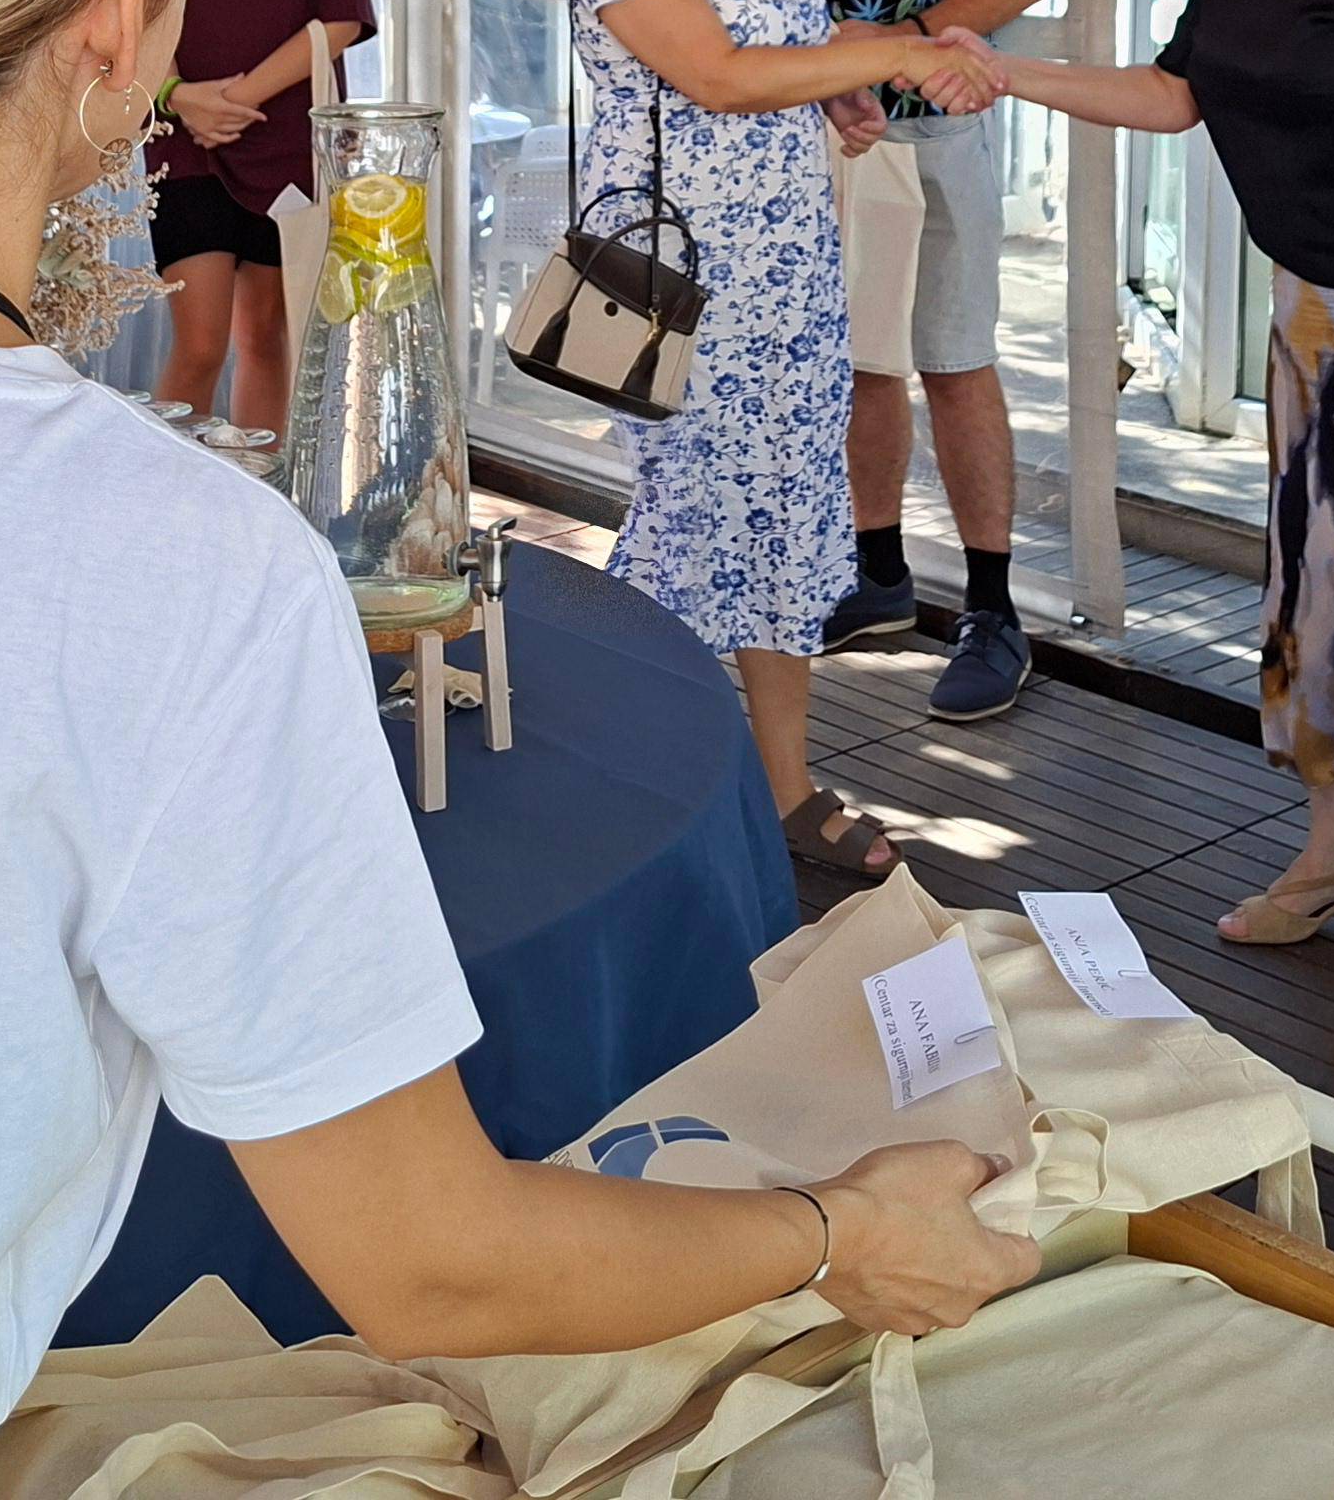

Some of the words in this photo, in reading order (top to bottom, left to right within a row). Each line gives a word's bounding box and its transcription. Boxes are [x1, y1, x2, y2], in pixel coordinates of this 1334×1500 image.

[1066, 926, 1092, 957] ANJA
[886, 1020, 898, 1036] za
[909, 1000, 930, 1033] ANA
